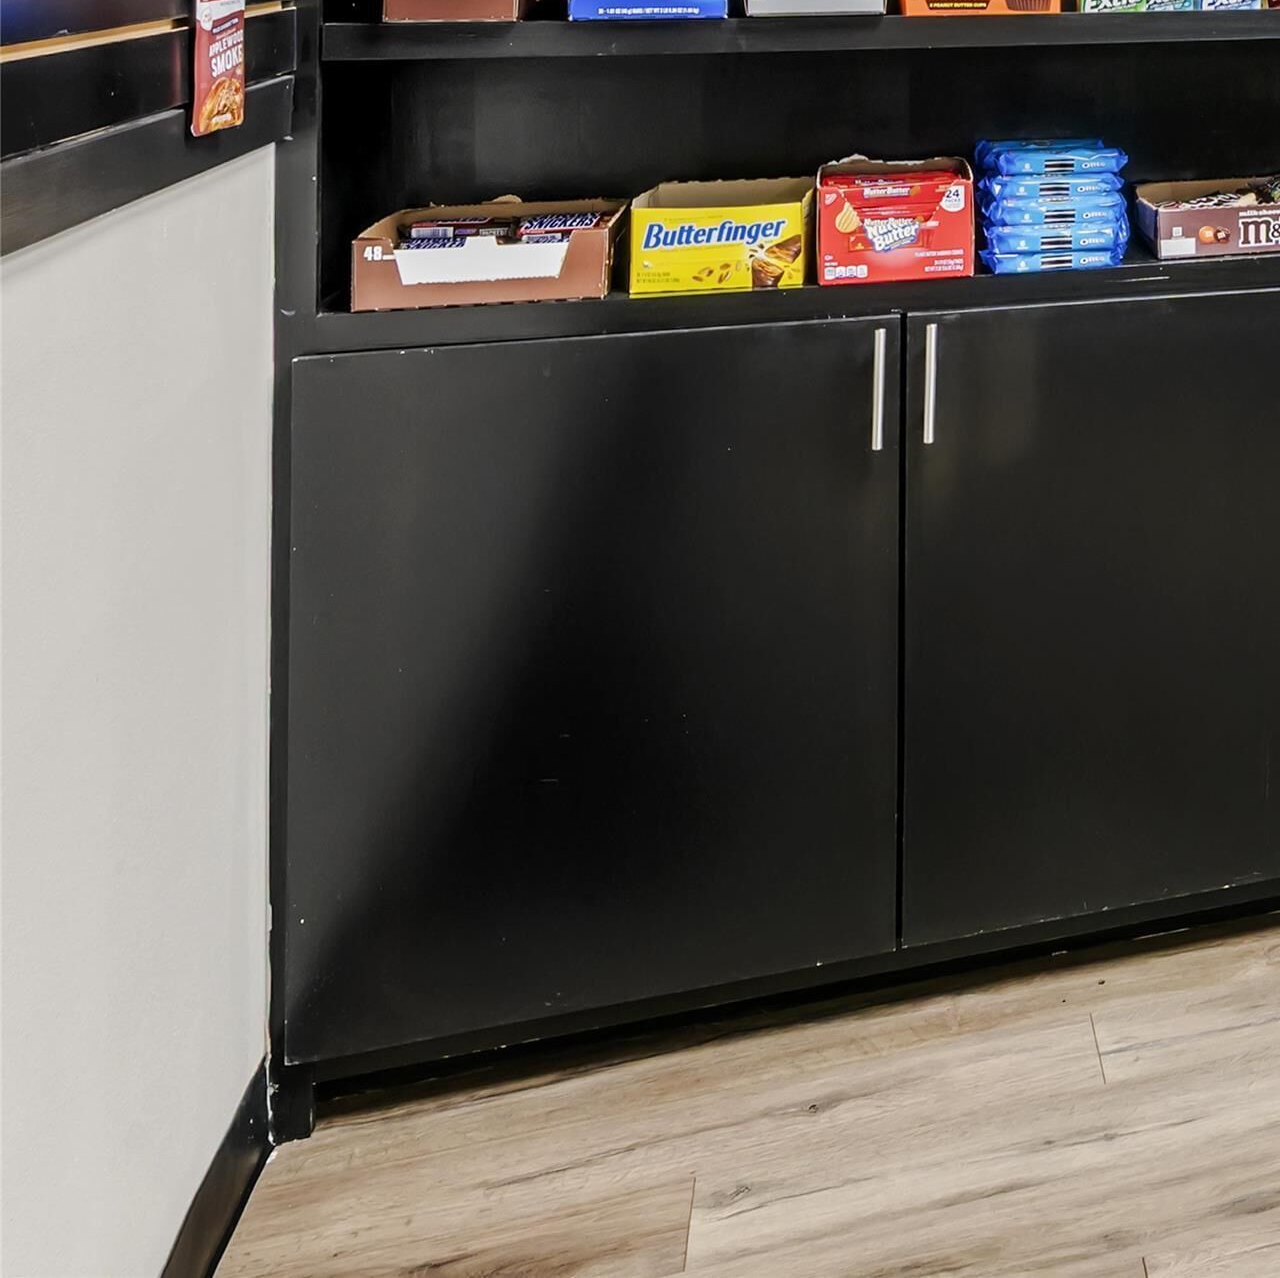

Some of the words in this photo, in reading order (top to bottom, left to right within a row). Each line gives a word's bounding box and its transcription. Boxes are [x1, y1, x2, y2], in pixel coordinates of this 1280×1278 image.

[946, 189, 960, 199] 24
[642, 219, 787, 250] Butterfinger
[874, 226, 919, 251] Butter
[364, 246, 383, 261] 48
